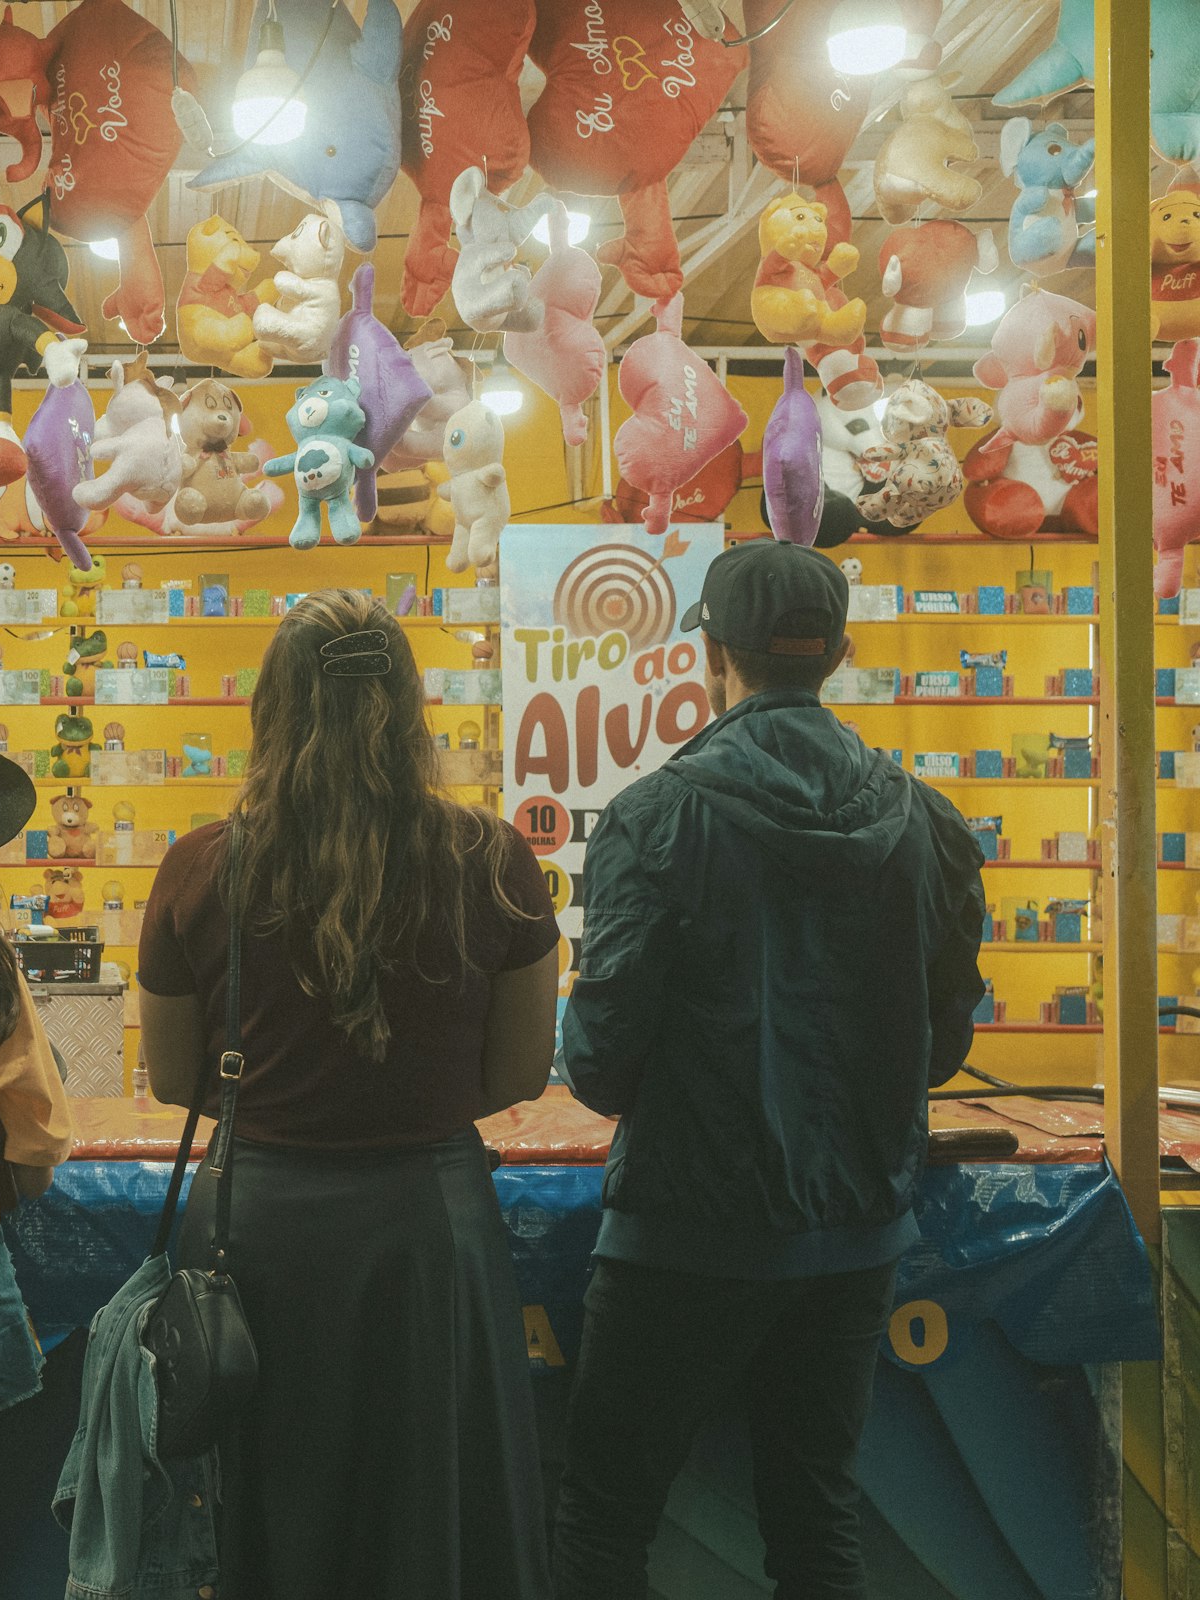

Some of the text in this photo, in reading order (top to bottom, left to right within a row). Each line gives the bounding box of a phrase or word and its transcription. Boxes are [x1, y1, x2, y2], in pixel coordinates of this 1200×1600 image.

[569, 0, 615, 139] Eu Amo
[662, 17, 696, 98] Você
[97, 60, 128, 142] Você
[419, 14, 453, 159] Eu Amo
[53, 153, 76, 200] Eu
[1160, 272, 1197, 291] Puff
[349, 344, 360, 383] MO
[26, 592, 39, 600] 200
[154, 592, 167, 600] 200
[514, 627, 627, 683] Tiro
[633, 642, 697, 685] ao
[23, 672, 39, 680] 100
[152, 671, 167, 679] 100
[515, 681, 710, 794] Alvo
[154, 833, 167, 842] 20
[527, 806, 556, 833] 10
[17, 912, 29, 921] 20
